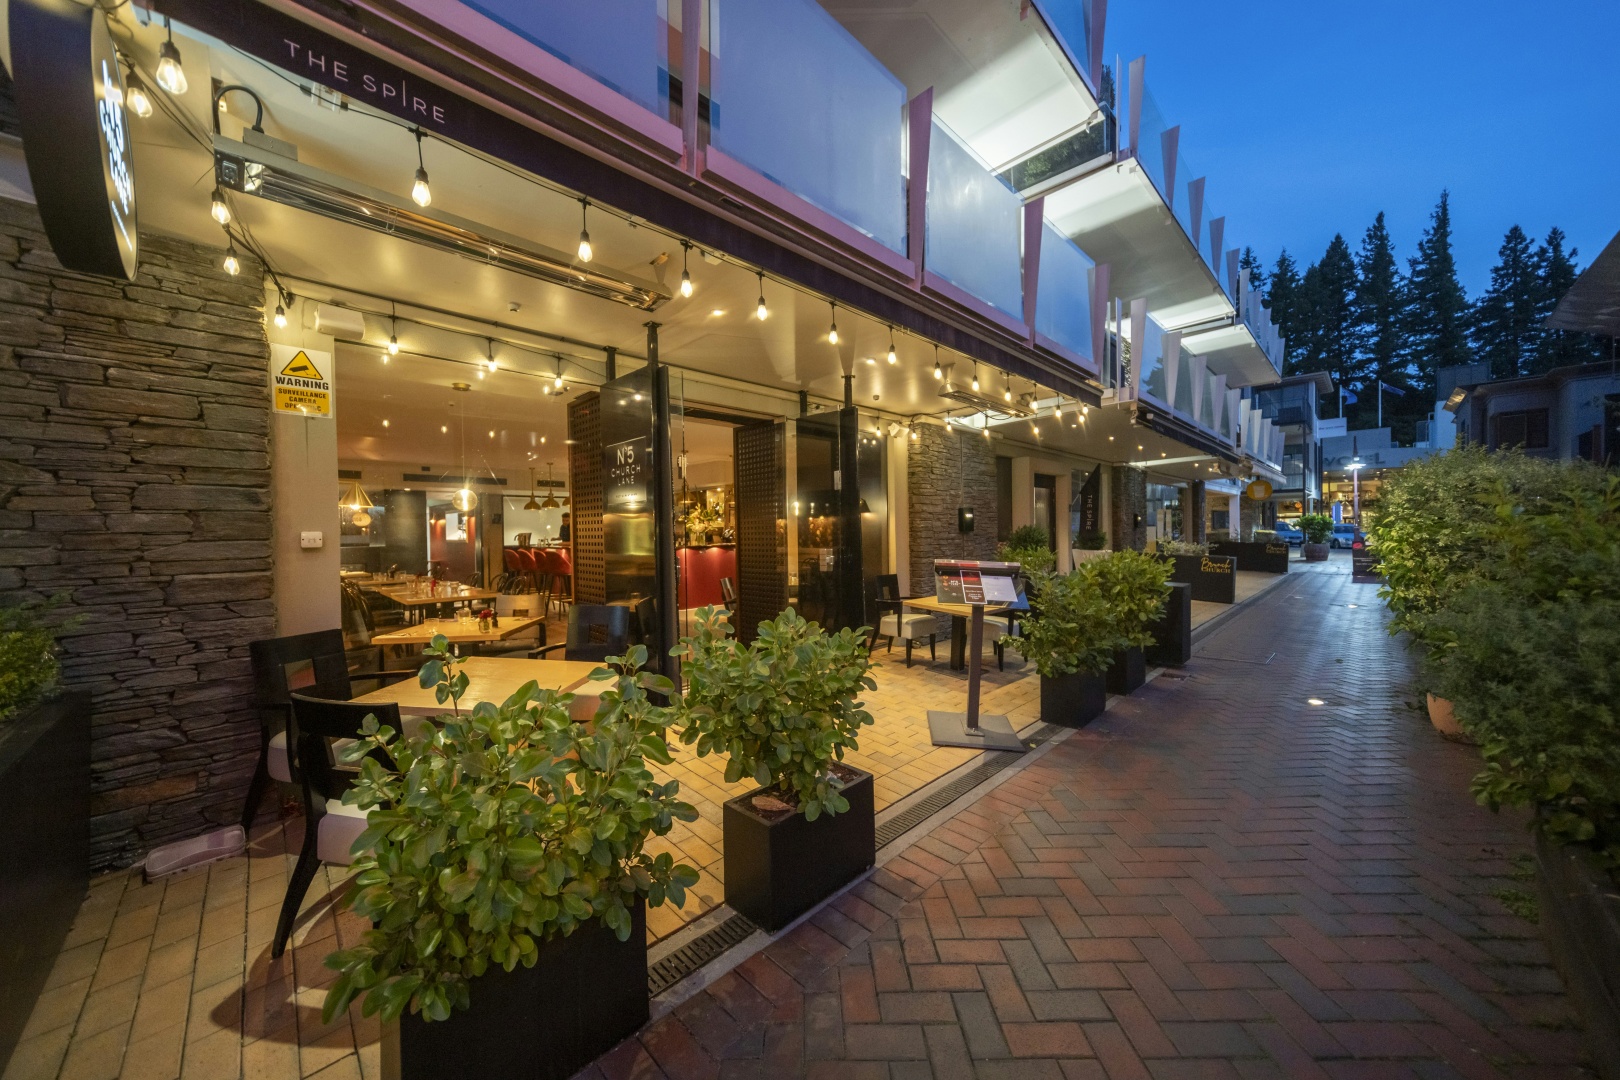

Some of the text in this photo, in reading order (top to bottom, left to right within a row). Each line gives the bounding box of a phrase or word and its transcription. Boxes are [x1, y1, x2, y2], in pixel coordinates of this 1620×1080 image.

[284, 39, 445, 124] THE SPIRE
[275, 376, 329, 390] WARNING
[278, 388, 327, 399] SURVEILLANCE
[288, 396, 317, 405] CAMERA
[611, 464, 641, 477] CHURCH
[617, 476, 635, 486] LANE
[1085, 510, 1095, 530] SPIRE
[1201, 557, 1231, 569] Brunch
